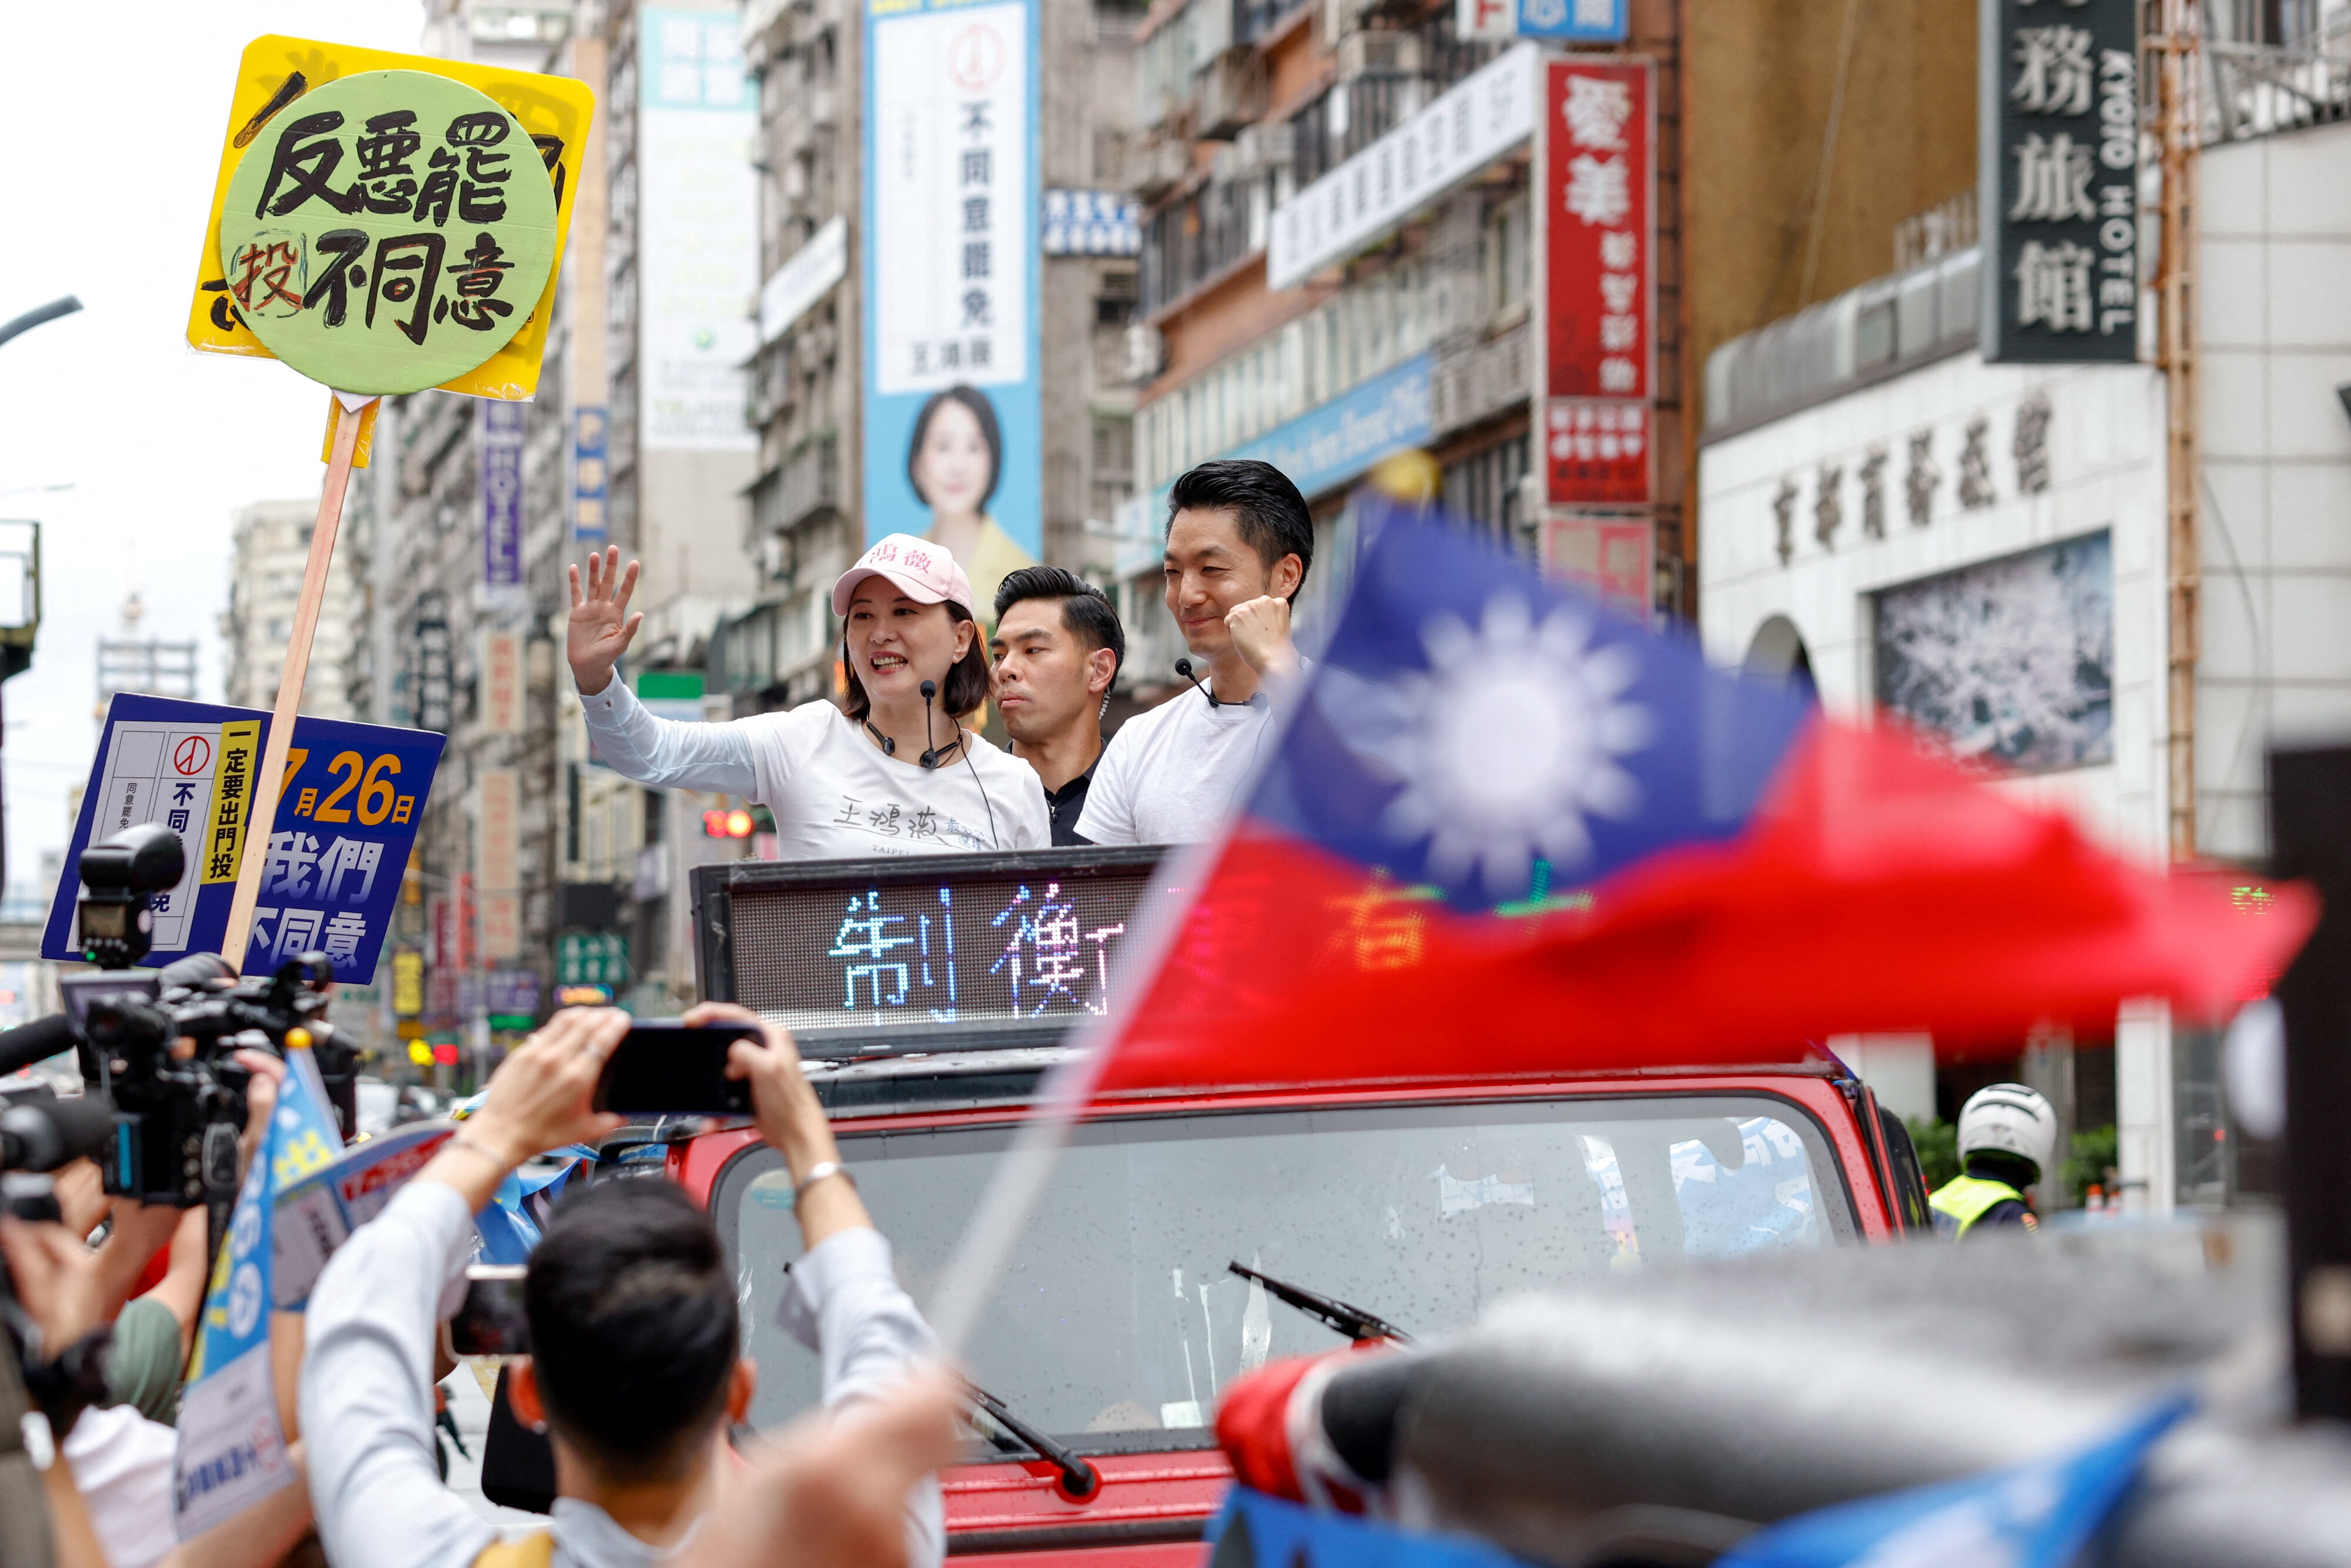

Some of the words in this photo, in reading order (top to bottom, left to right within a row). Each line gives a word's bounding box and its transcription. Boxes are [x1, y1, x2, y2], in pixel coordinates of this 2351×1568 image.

[256, 110, 514, 227] 反惡罷
[2009, 0, 2098, 333] 務旅館
[2099, 185, 2135, 337] HOTEL
[859, 543, 933, 574] 鴻薇
[119, 782, 138, 829] 同意罷免
[210, 731, 252, 879] 一定要出門投
[277, 748, 415, 826] 7月26日
[152, 783, 196, 913] 不同免
[260, 830, 385, 904] 我們
